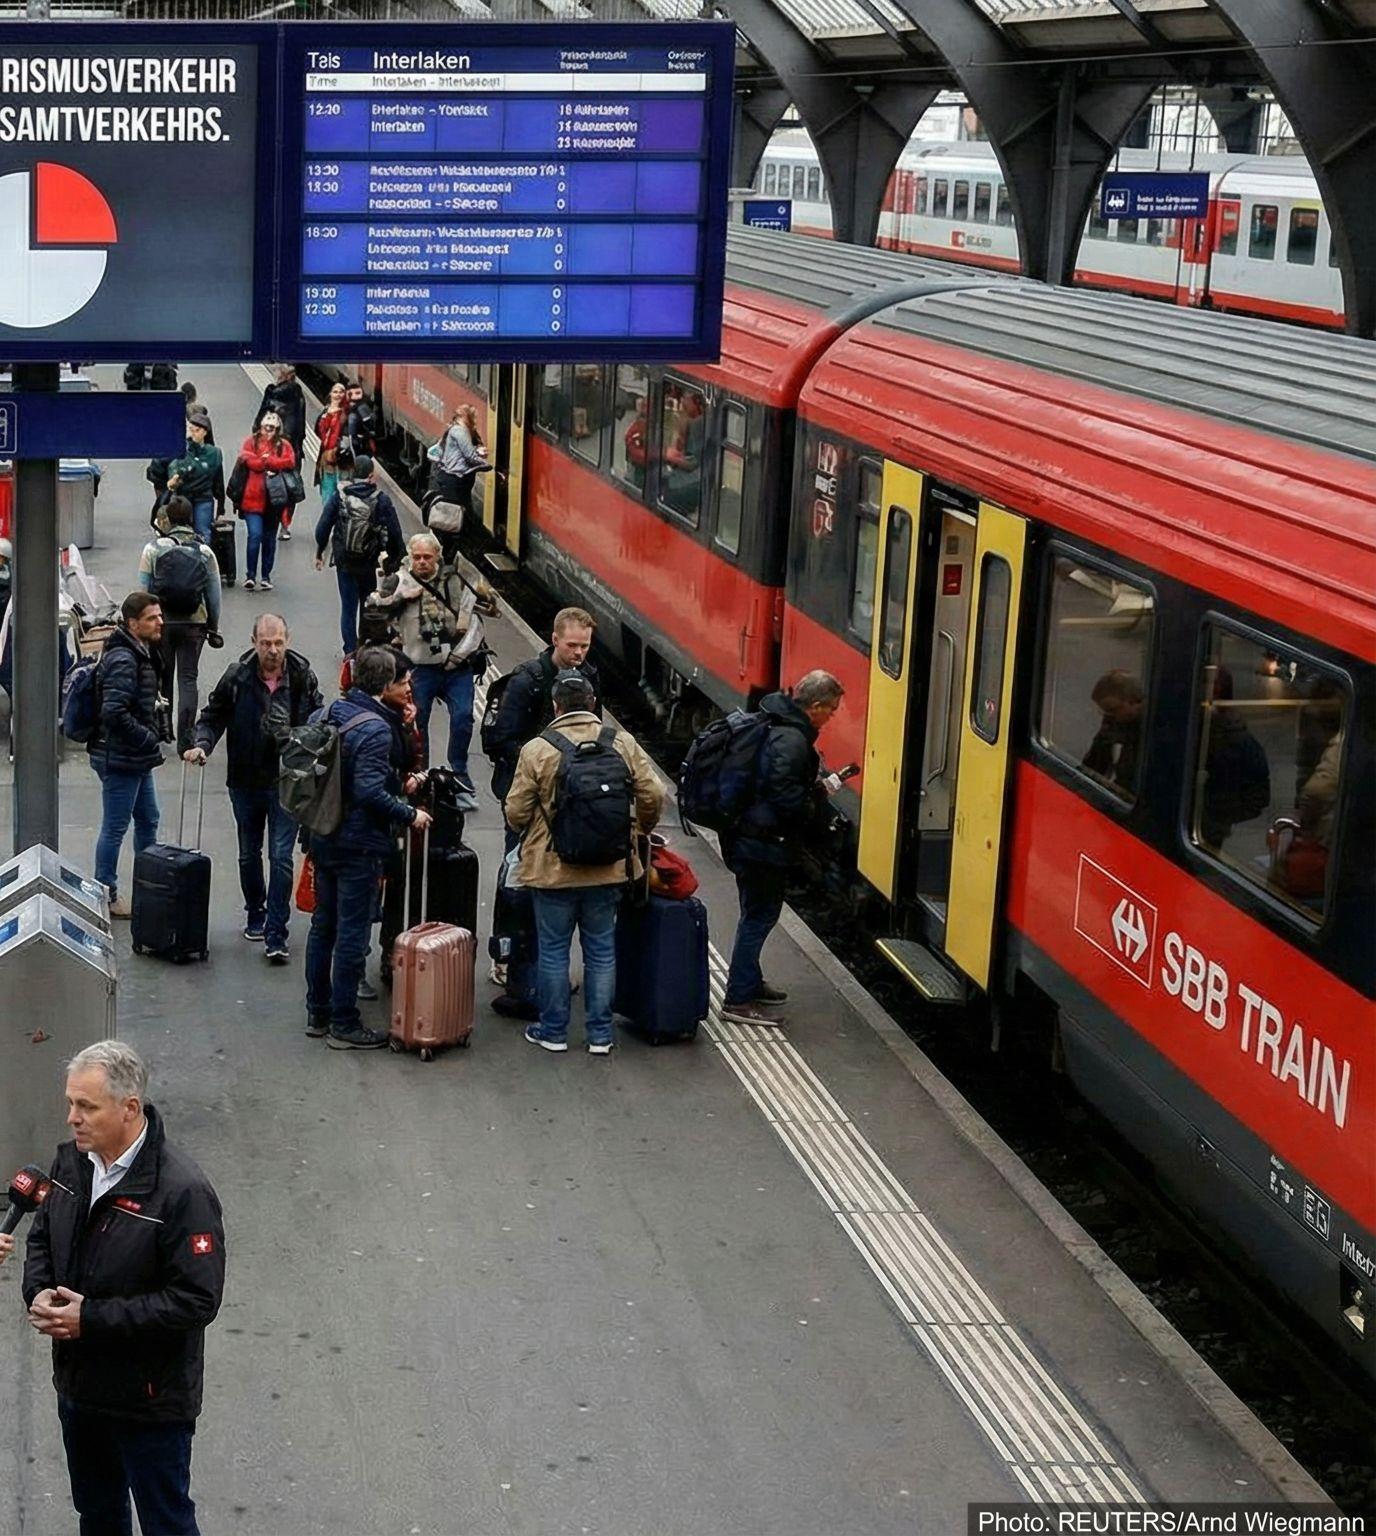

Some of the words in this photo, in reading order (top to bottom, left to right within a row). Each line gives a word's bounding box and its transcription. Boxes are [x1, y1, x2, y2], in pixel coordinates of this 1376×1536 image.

[374, 51, 470, 69] Interlaken
[1162, 931, 1228, 1031] SBB
[1239, 983, 1350, 1128] TRAIN
